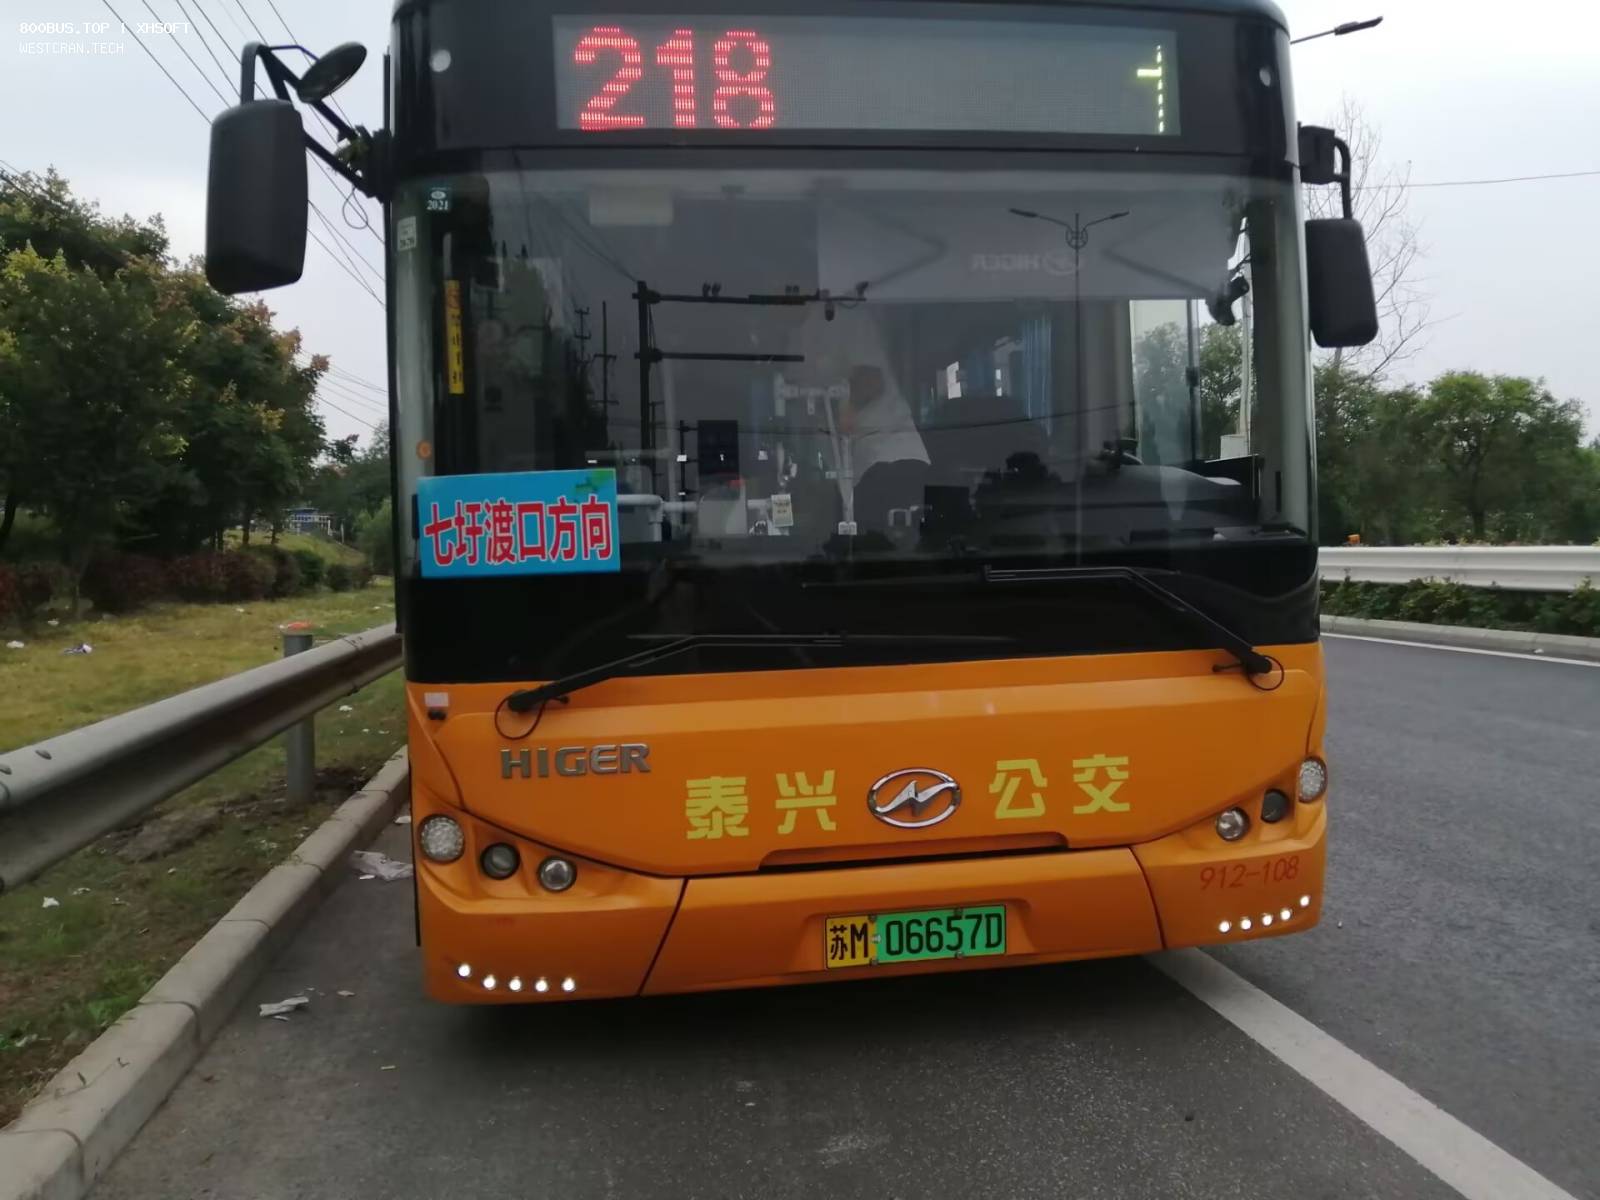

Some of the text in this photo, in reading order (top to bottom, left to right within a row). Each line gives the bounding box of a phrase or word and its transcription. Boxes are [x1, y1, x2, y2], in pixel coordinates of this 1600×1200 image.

[574, 27, 774, 131] 218
[427, 199, 449, 211] 2021
[424, 493, 613, 567] 七圩渡口方向
[501, 743, 651, 778] HIGER
[686, 754, 1131, 839] 泰兴 公交
[1200, 856, 1300, 890] 912-108
[829, 912, 1003, 961] 苏M 06657D
